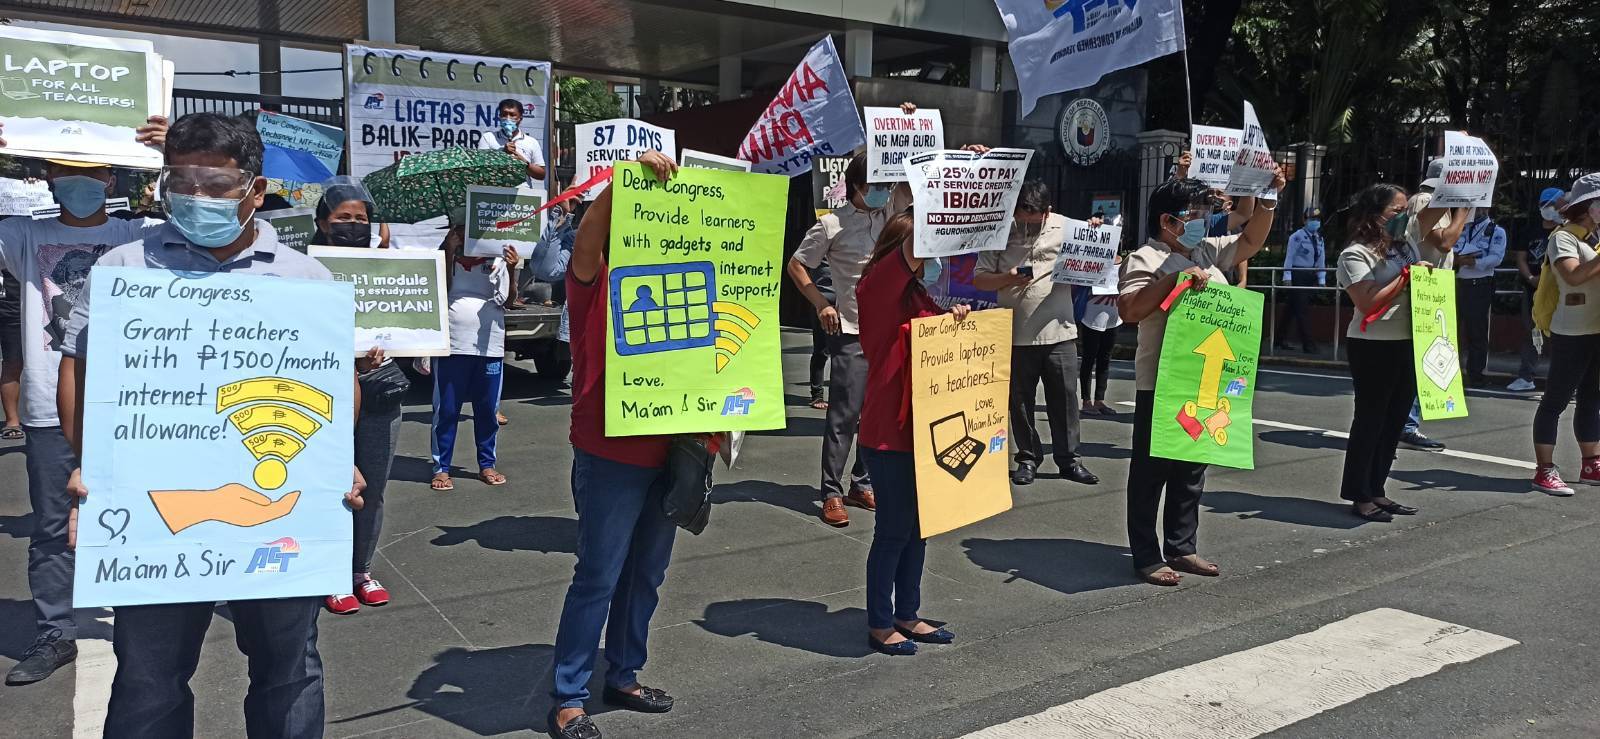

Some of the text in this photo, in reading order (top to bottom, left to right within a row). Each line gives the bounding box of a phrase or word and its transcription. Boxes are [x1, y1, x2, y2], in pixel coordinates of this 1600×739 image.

[5, 54, 130, 81] LAPTOP
[32, 78, 101, 93] FOR ALL
[41, 90, 136, 109] TEACHERS!
[394, 98, 465, 125] LIGTAS
[874, 117, 934, 131] OVERTIME PAY
[593, 124, 663, 152] 87 DAYS
[874, 134, 936, 147] NG MGA GURO
[1196, 134, 1239, 148] OVERTIME PAY
[586, 149, 630, 163] SERVICE
[1195, 149, 1205, 159] NG
[1207, 149, 1221, 160] MGA
[943, 167, 1018, 180] 25% OT PAY
[1199, 163, 1219, 174] IBIGAY
[1444, 170, 1475, 185] NASAAN
[623, 169, 656, 191] Dear
[664, 178, 725, 201] Congress,
[927, 181, 941, 189] AT
[943, 181, 982, 190] SERVICE
[490, 202, 536, 212] PONDO SA
[943, 192, 1003, 209] IBIGAY!
[634, 203, 756, 232] Provide learners
[928, 214, 942, 223] NO
[944, 214, 956, 222] TO
[956, 212, 970, 222] PVP
[1073, 226, 1112, 245] LIGTAS NA
[623, 234, 744, 256] with gadgets and
[1061, 242, 1116, 260] BALIK-PAARALAN
[720, 261, 773, 277] internet
[1062, 258, 1105, 275] IPAGLABAN!
[351, 272, 429, 286] 1:1 module
[111, 277, 254, 307] Dear Congress,
[368, 286, 429, 299] estudyante
[721, 281, 779, 301] support!
[1183, 291, 1246, 319] Higher budget
[123, 318, 300, 341] Grant teachers
[918, 319, 978, 338] Dear Congress,
[1185, 309, 1252, 336] to education!
[124, 345, 178, 369] with
[920, 342, 996, 369] Provide laptops
[929, 362, 995, 396] to teachers!
[118, 383, 207, 407] internet
[220, 383, 238, 395] 500
[621, 400, 673, 420] Ma'am
[697, 397, 717, 412] Sir
[721, 395, 755, 416] ACT
[974, 397, 995, 411] Love,
[234, 409, 250, 422] 500
[993, 411, 1005, 425] Sir
[114, 413, 228, 440] allowance!
[248, 434, 265, 447] 500
[95, 549, 236, 583] Ma'am & Sir
[244, 547, 300, 574] ACT
